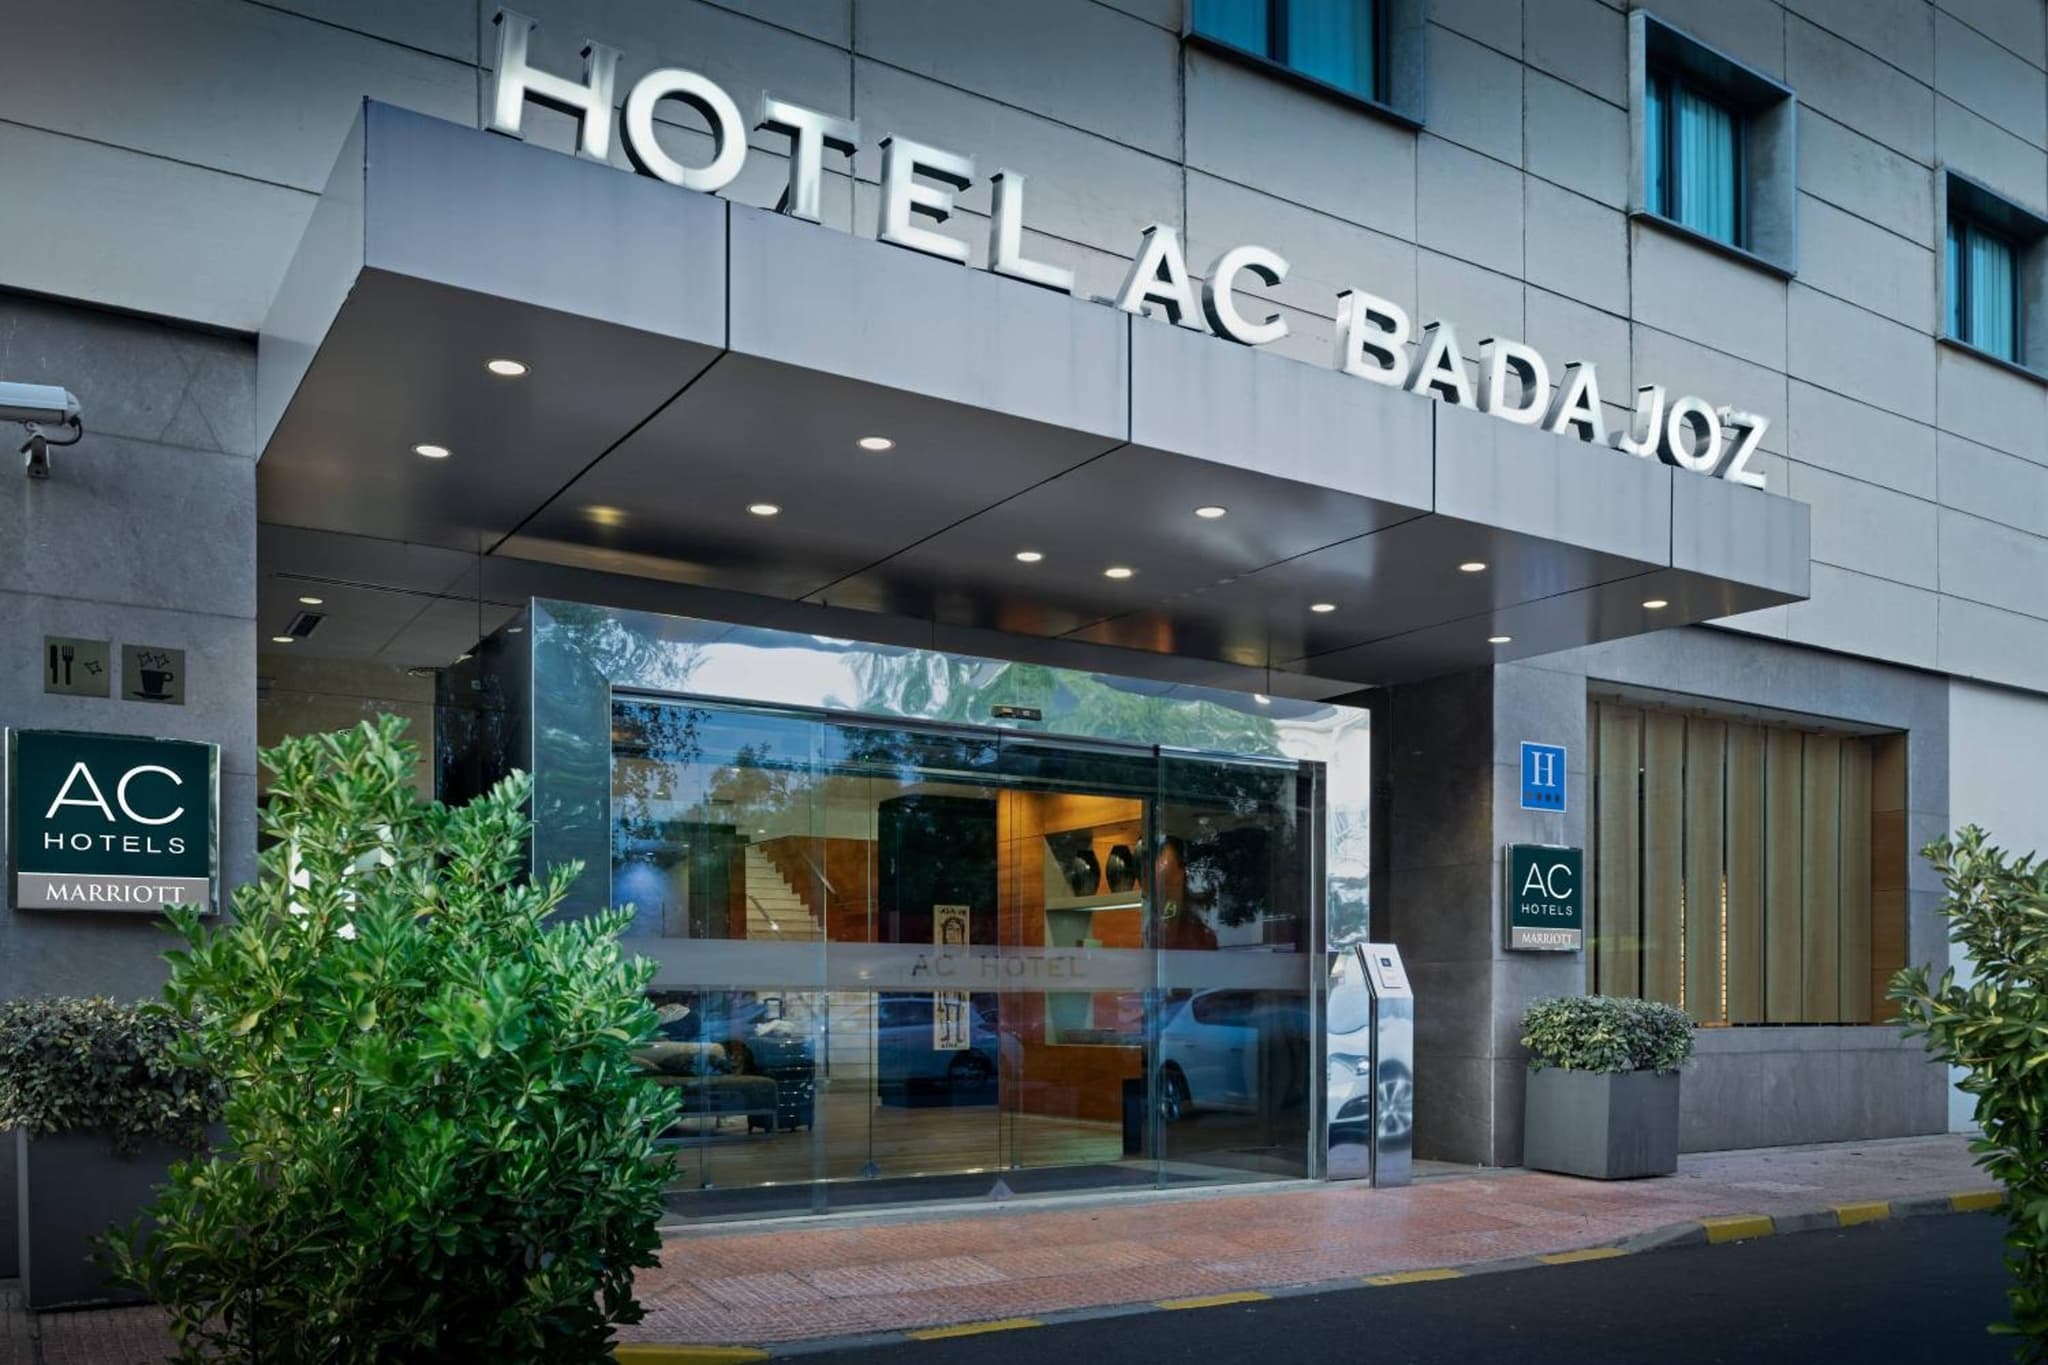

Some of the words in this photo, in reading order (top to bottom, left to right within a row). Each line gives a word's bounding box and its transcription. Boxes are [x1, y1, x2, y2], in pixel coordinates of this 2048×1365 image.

[485, 8, 1074, 295] HOTEL
[1117, 222, 1291, 345] AC
[1336, 288, 1770, 490] BADAJOZ
[1531, 751, 1556, 787] H
[45, 761, 185, 825] AC
[44, 832, 186, 855] HOTELS
[1521, 862, 1573, 900] AC
[45, 883, 185, 904] MARRIOTT
[1521, 903, 1573, 917] HOTELS
[1520, 930, 1573, 945] MARRIOTT
[911, 954, 954, 977] AC
[979, 955, 1087, 978] HOTEL
